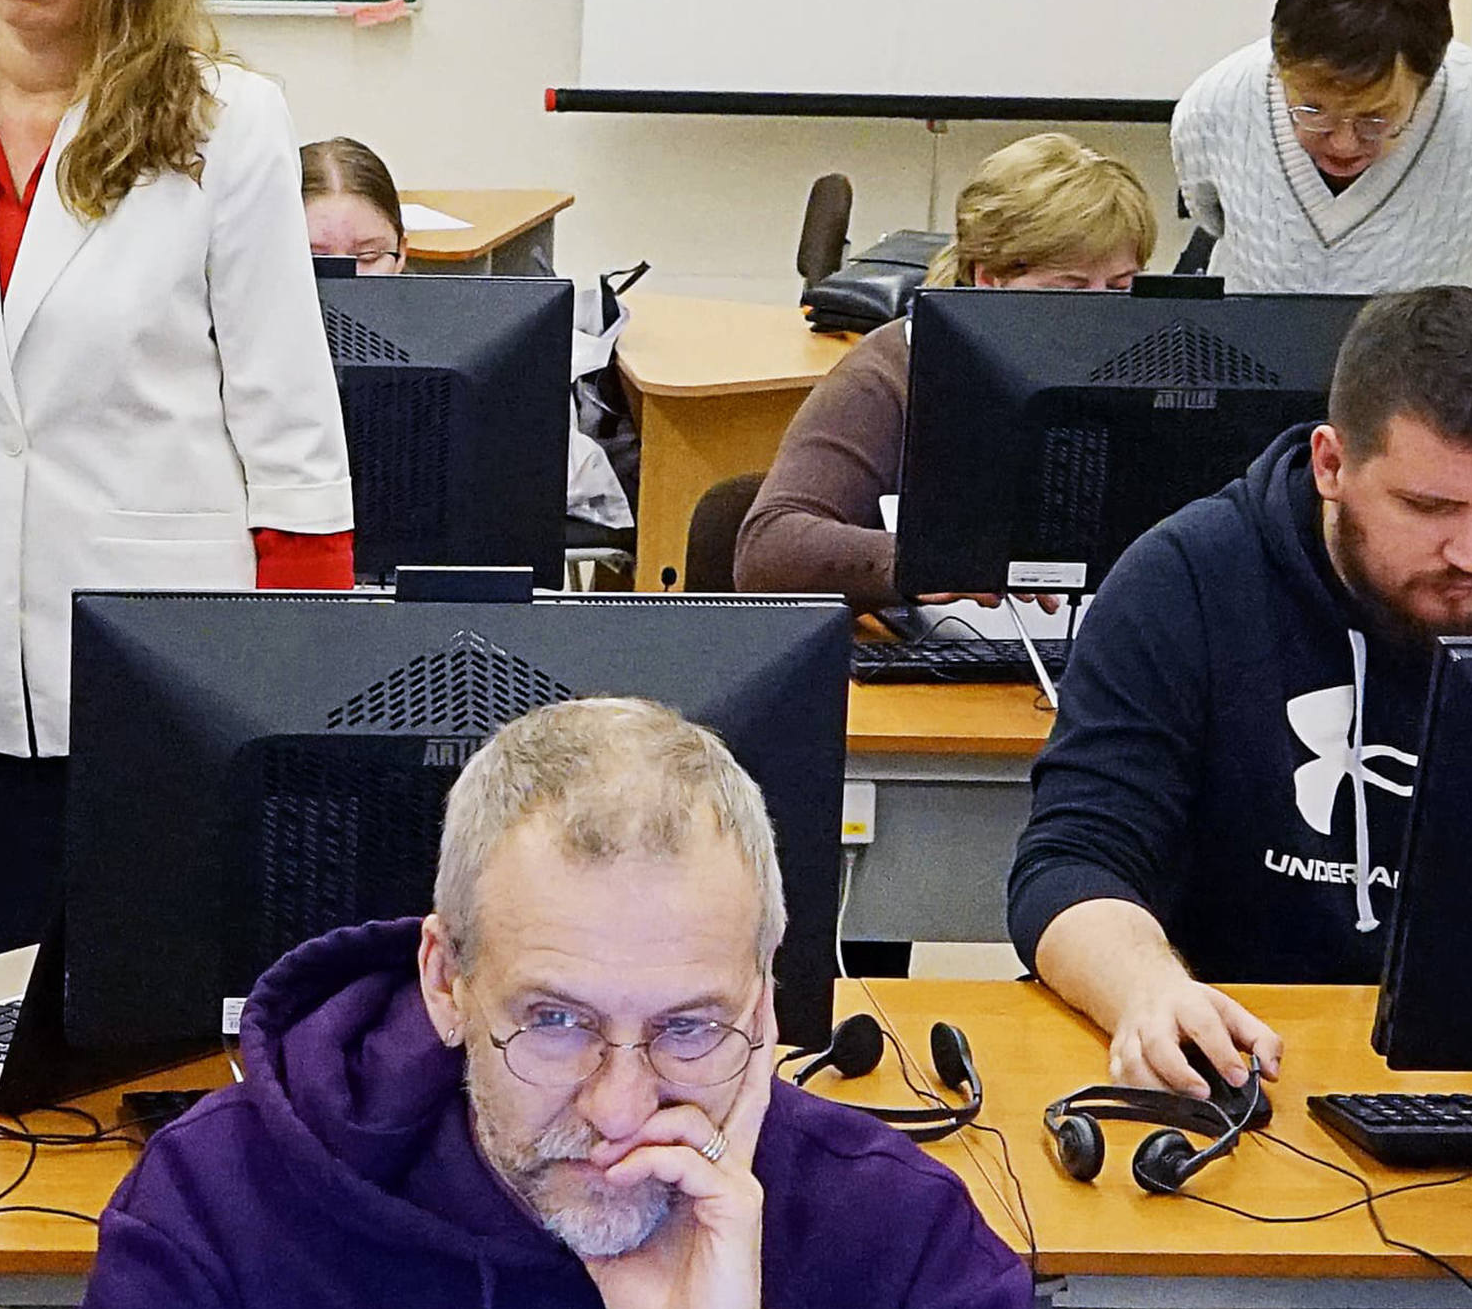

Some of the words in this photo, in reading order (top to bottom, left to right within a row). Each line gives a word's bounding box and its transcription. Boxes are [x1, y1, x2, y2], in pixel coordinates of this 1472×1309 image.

[1153, 389, 1217, 408] ARTLINE
[1265, 849, 1359, 885] UNDER
[1367, 866, 1400, 889] A
